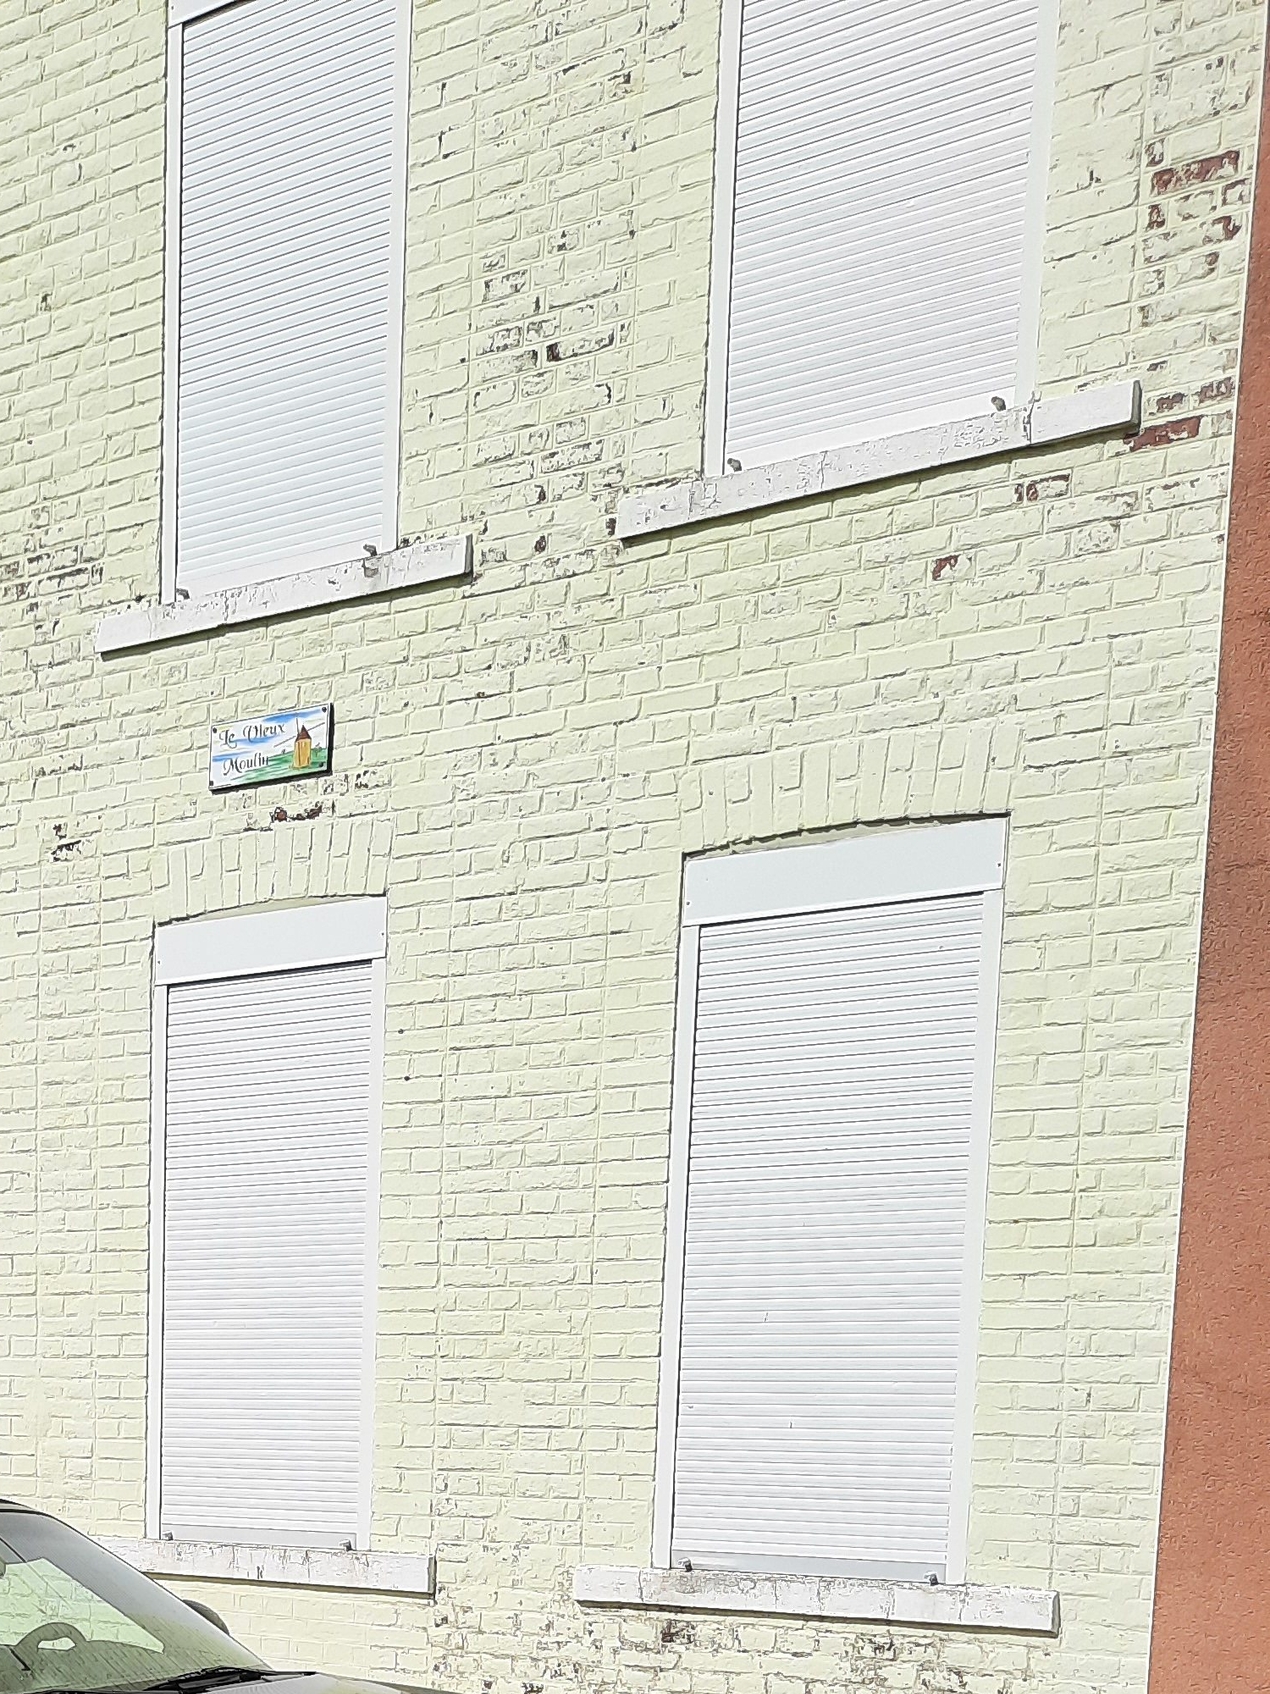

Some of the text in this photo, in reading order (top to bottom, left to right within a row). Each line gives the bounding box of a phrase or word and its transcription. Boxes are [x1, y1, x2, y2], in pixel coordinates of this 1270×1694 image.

[219, 723, 286, 749] Le Vieux
[223, 752, 269, 776] Moulin
